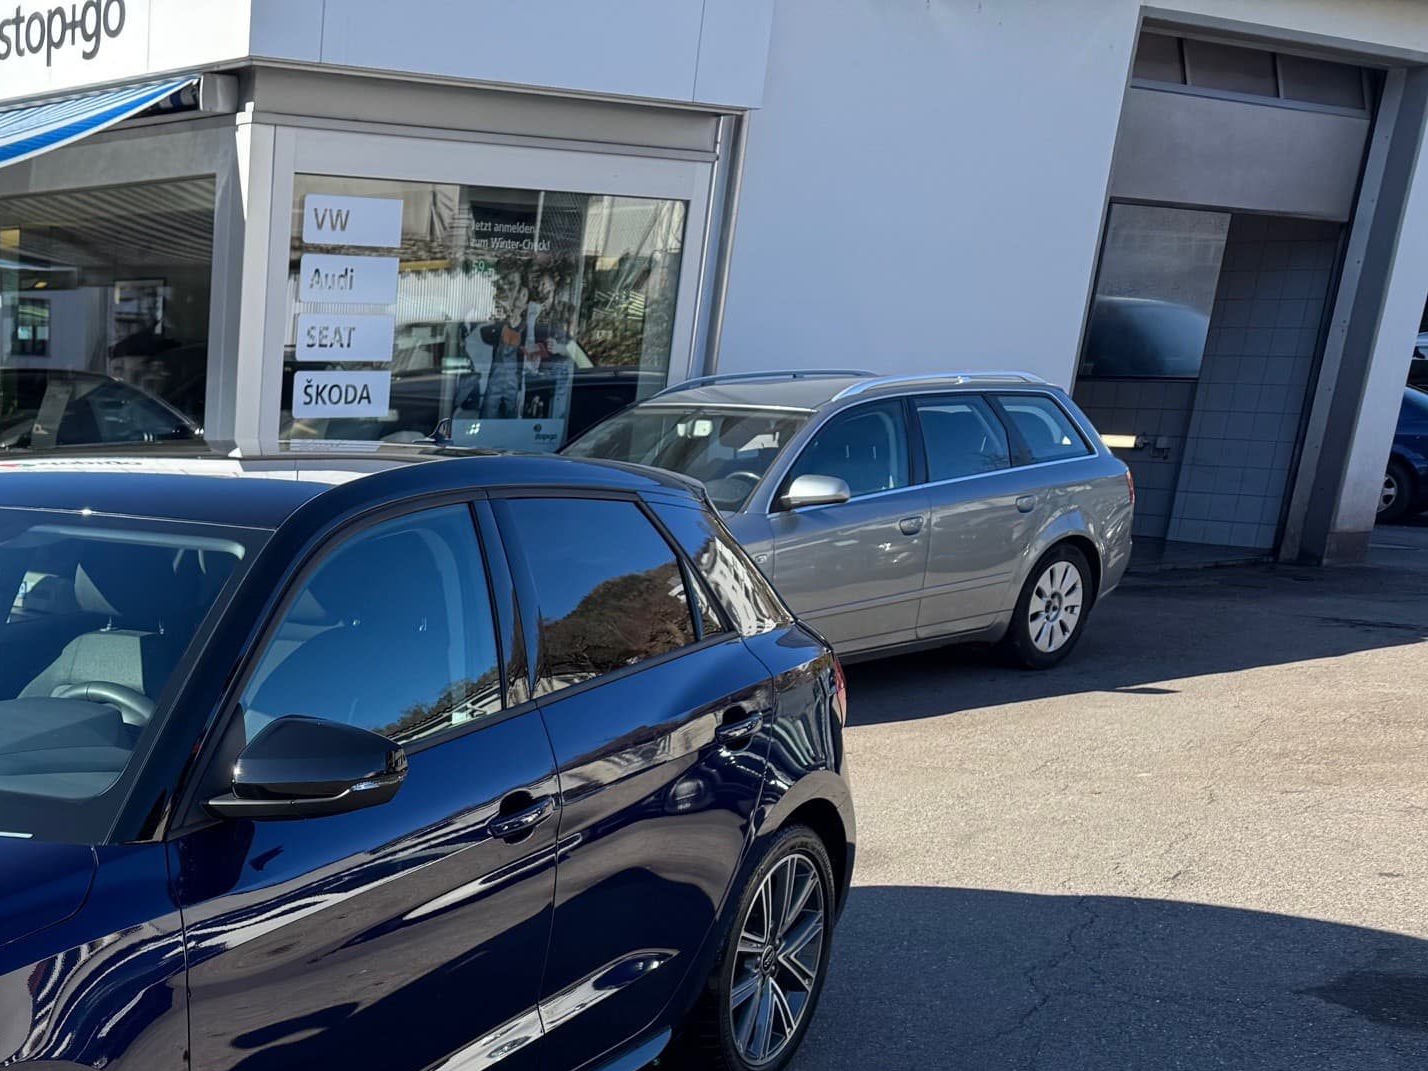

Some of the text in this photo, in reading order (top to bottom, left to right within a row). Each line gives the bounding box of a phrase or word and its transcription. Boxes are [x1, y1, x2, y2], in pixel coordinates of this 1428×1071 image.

[313, 207, 351, 232] VW
[493, 221, 535, 235] anmelden
[309, 267, 355, 291] Audi
[305, 325, 356, 349] SEAT
[303, 378, 372, 405] ŠKODA
